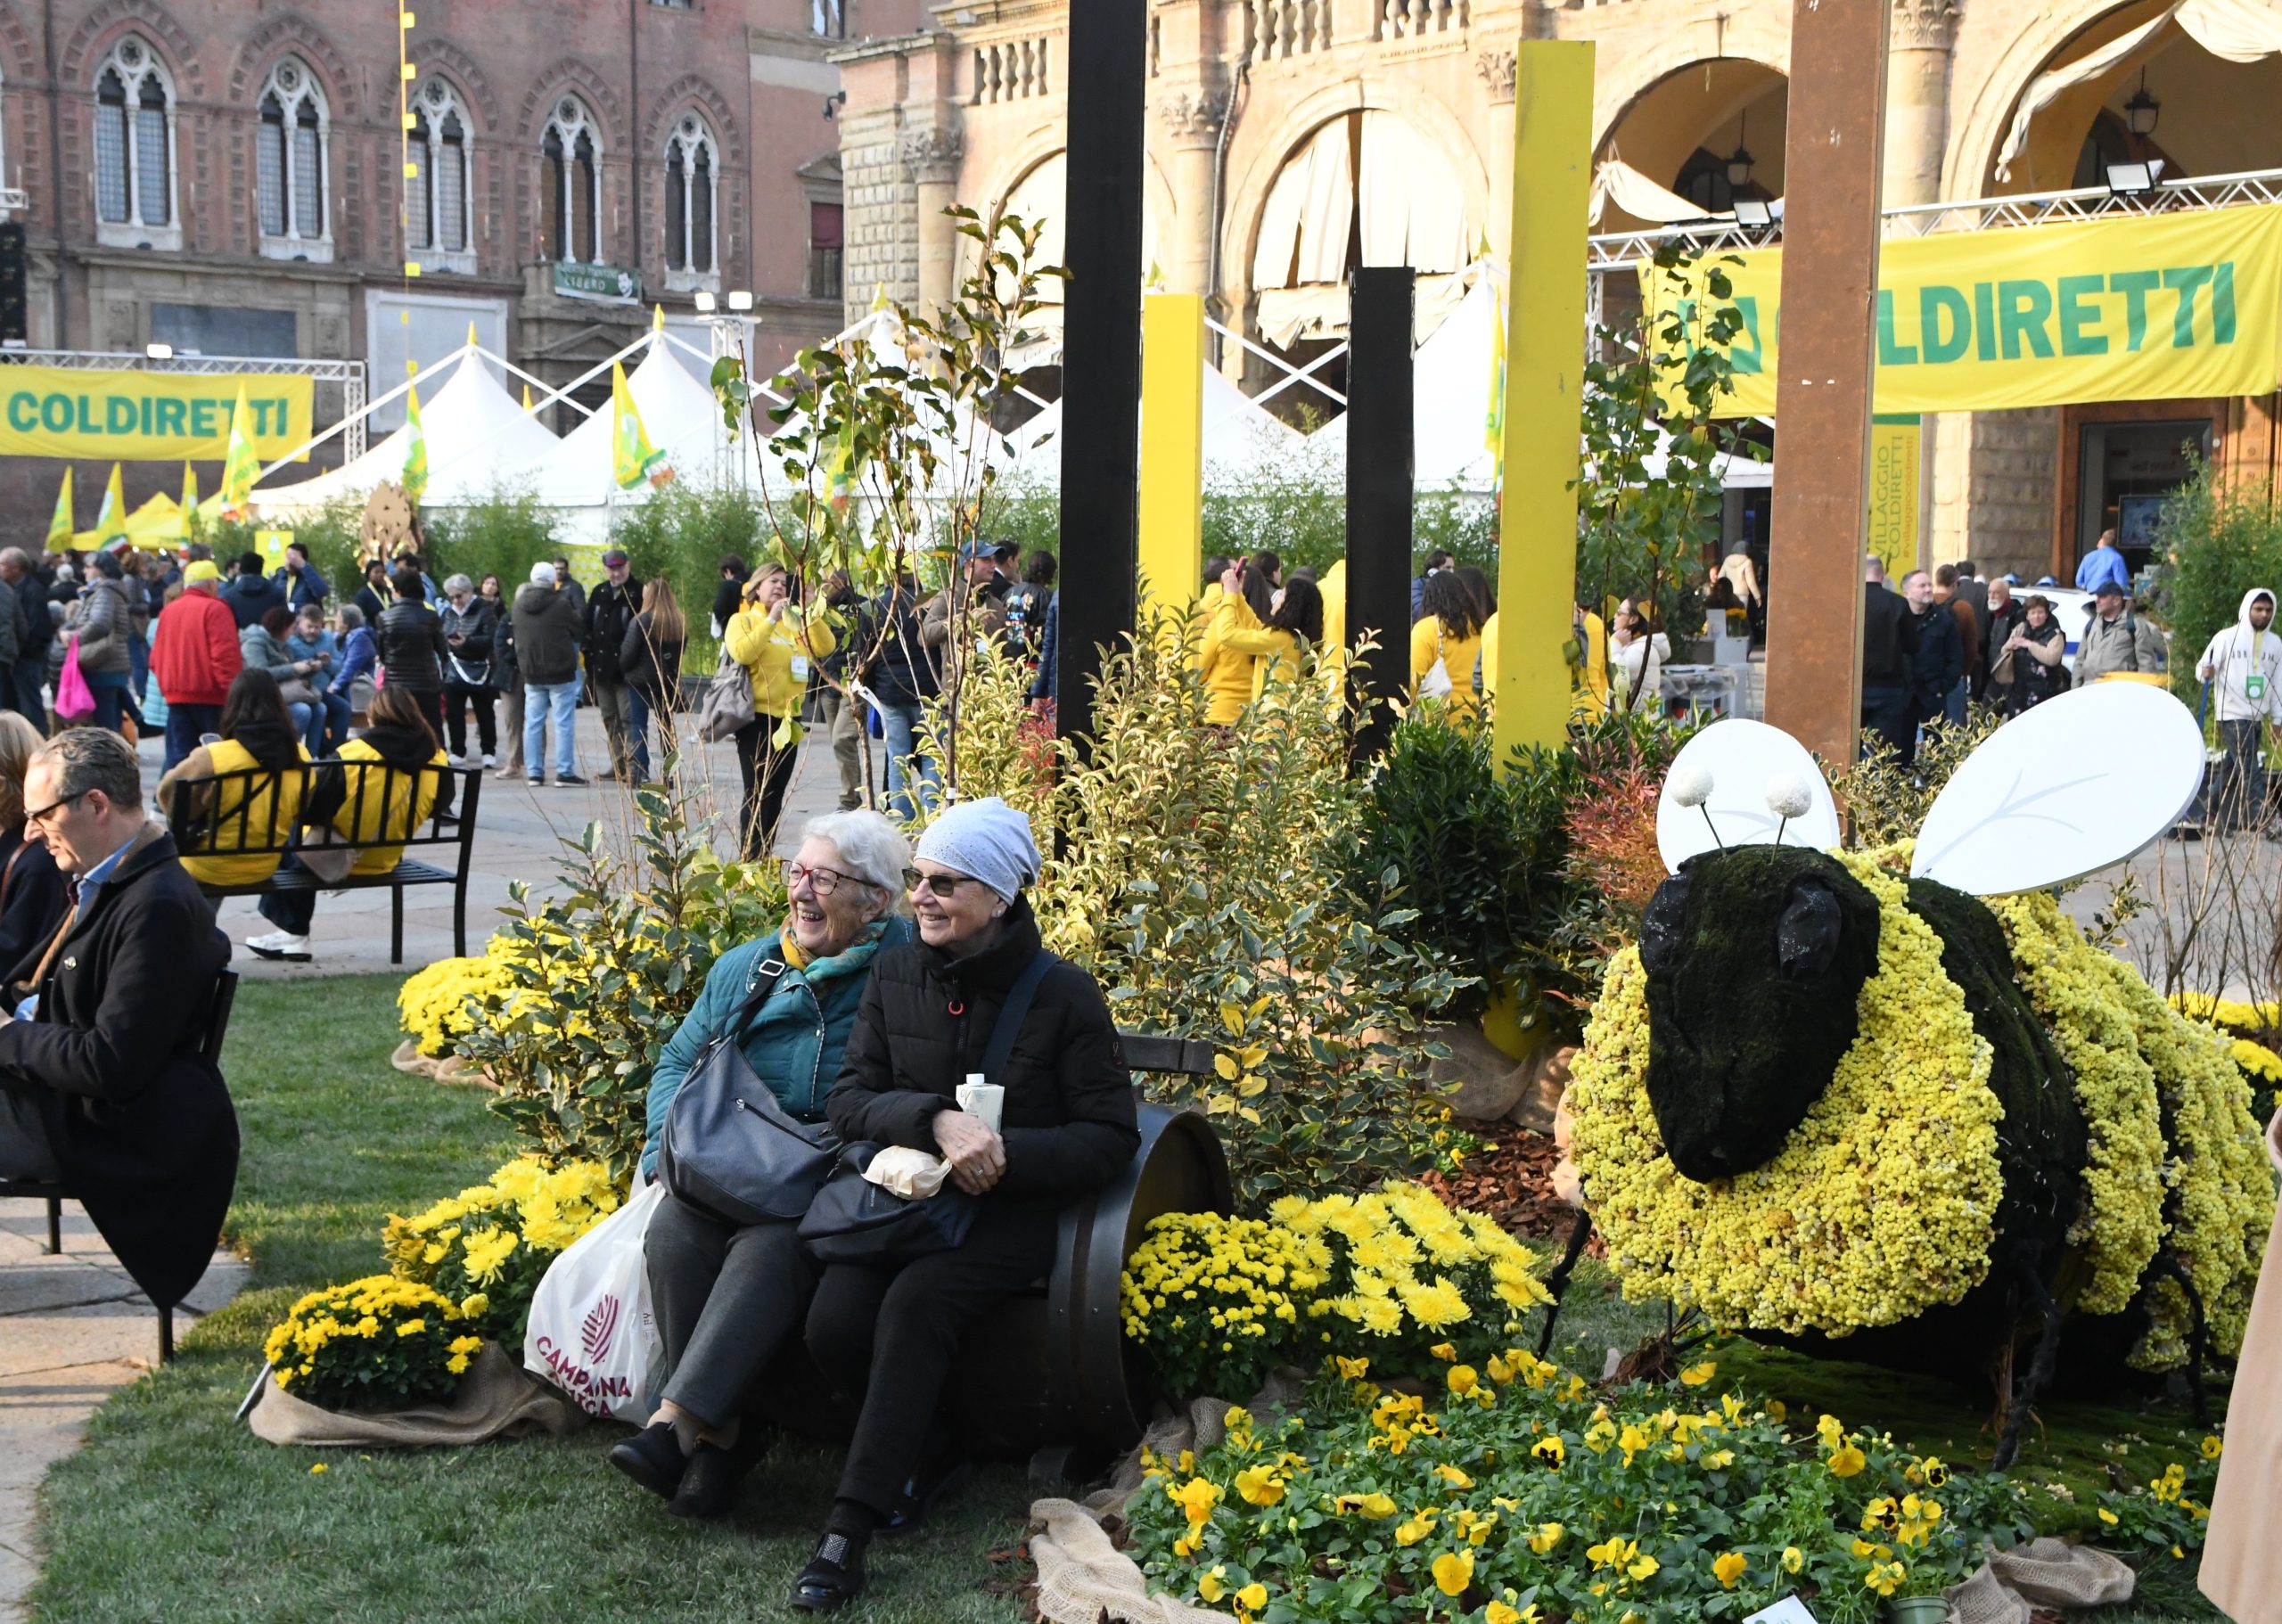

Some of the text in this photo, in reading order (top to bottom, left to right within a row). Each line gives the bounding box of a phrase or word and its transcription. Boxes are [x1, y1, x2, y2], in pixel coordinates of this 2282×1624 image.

[1776, 261, 2237, 365] LDIRETTI
[1875, 446, 1890, 557] VILLAGGIO
[1889, 435, 1903, 560] COLDIRETTI
[537, 1336, 632, 1398] CAMPANA
